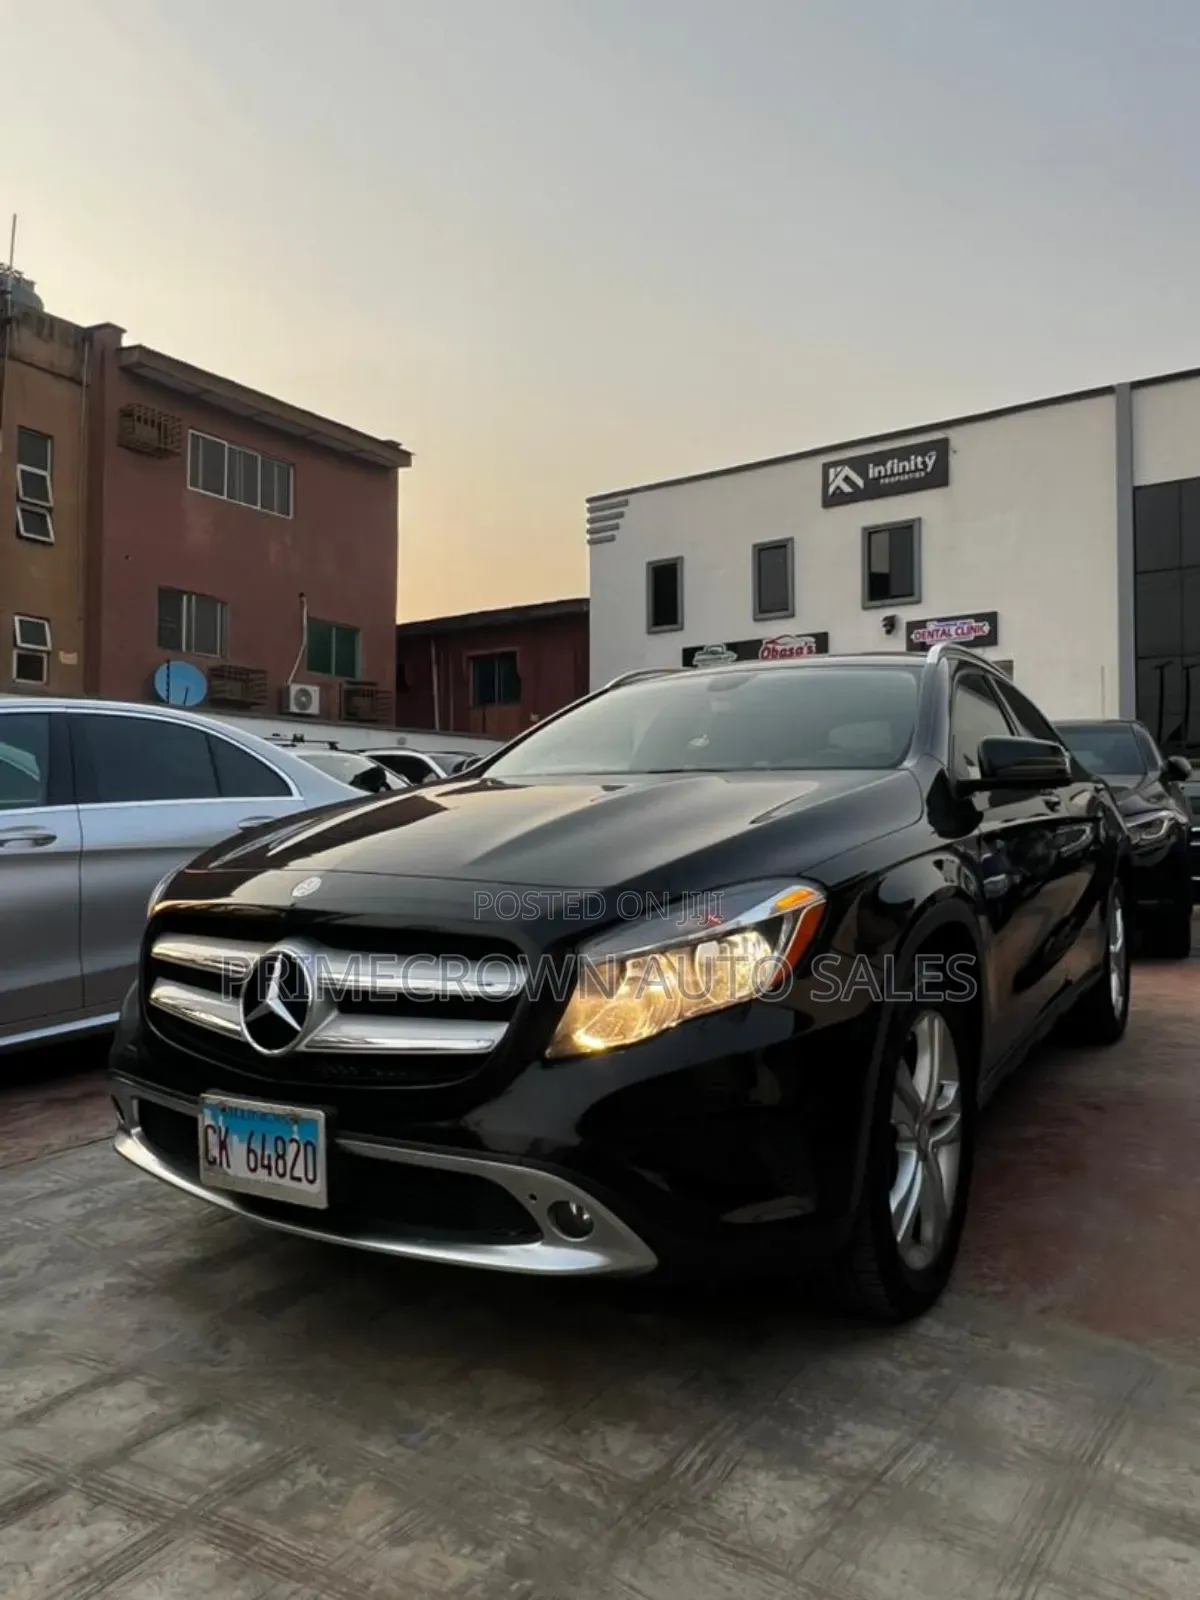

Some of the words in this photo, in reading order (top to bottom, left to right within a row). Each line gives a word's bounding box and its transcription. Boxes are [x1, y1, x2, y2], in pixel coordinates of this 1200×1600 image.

[868, 450, 937, 478] infinity
[914, 627, 952, 641] DENTAL
[955, 621, 990, 637] CLINIC
[760, 641, 814, 661] Obasa's
[204, 1124, 231, 1169] CK
[246, 1130, 317, 1184] 64820
